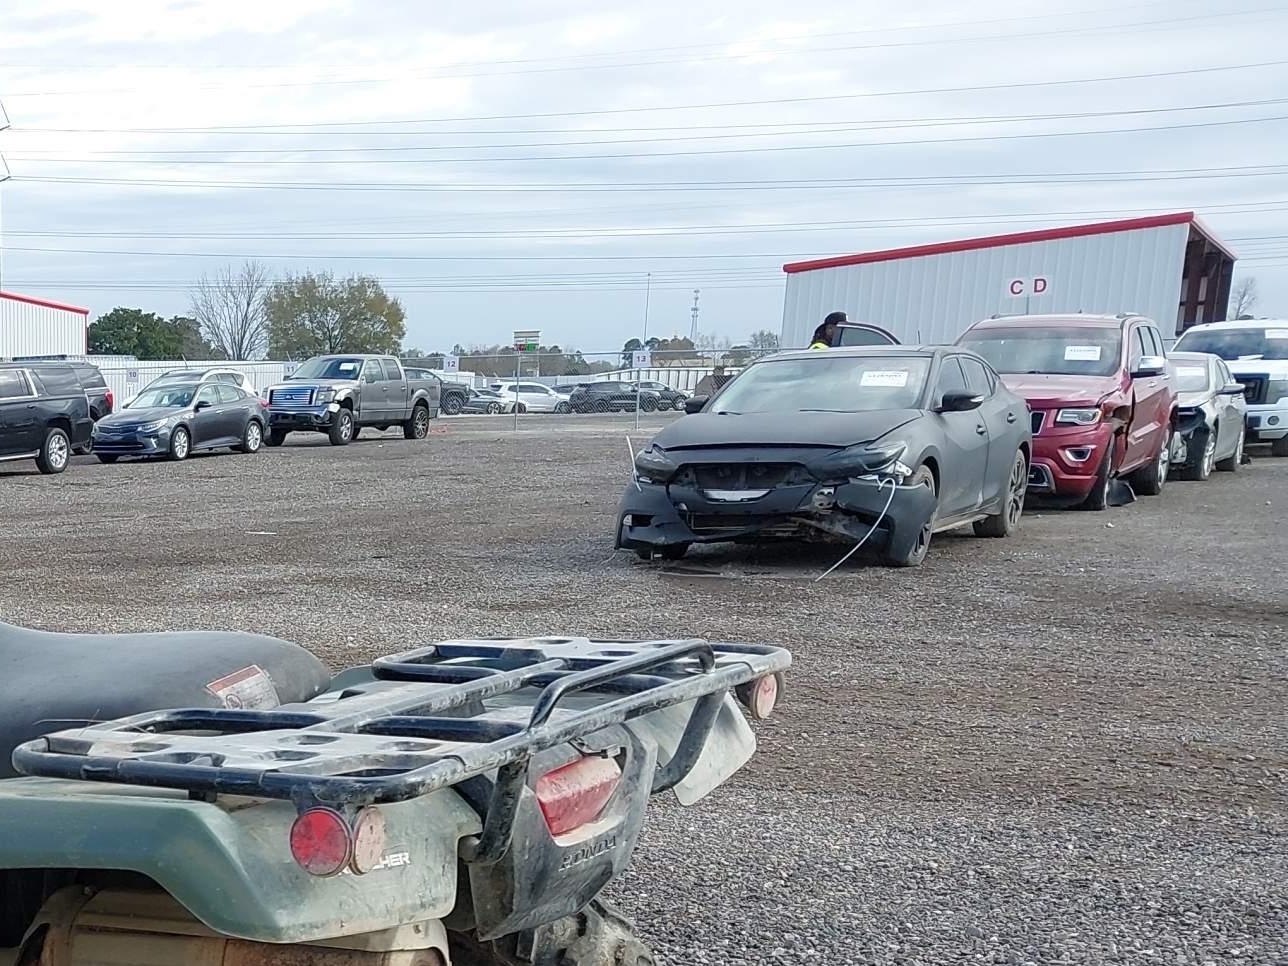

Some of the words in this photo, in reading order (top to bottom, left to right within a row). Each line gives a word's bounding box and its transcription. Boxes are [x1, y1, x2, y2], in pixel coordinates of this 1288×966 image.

[1010, 280, 1024, 295] C
[1034, 278, 1047, 293] D
[447, 360, 456, 368] 12
[558, 835, 617, 872] HONDA
